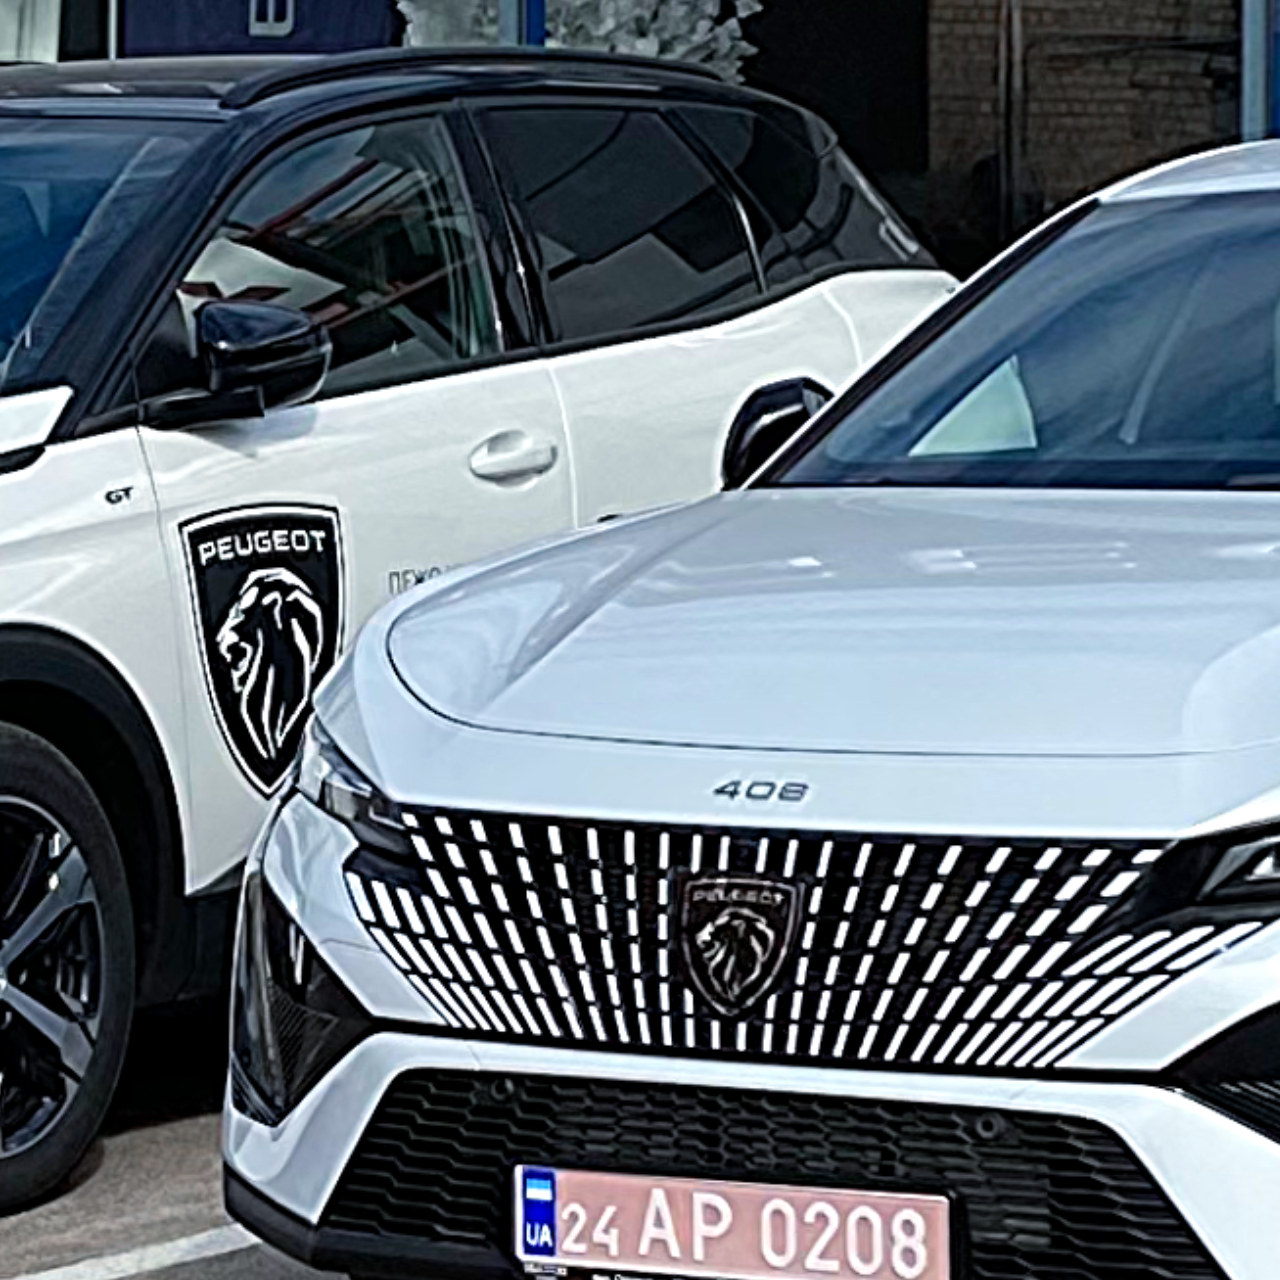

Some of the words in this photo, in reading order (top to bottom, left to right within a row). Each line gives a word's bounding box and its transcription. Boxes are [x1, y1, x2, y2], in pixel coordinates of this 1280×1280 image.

[105, 487, 133, 505] GT
[198, 529, 326, 565] PEUGEOT
[713, 780, 809, 802] 408
[525, 1222, 553, 1248] UA
[561, 1202, 619, 1256] 24
[638, 1187, 732, 1261] AP
[760, 1197, 928, 1280] 0208
